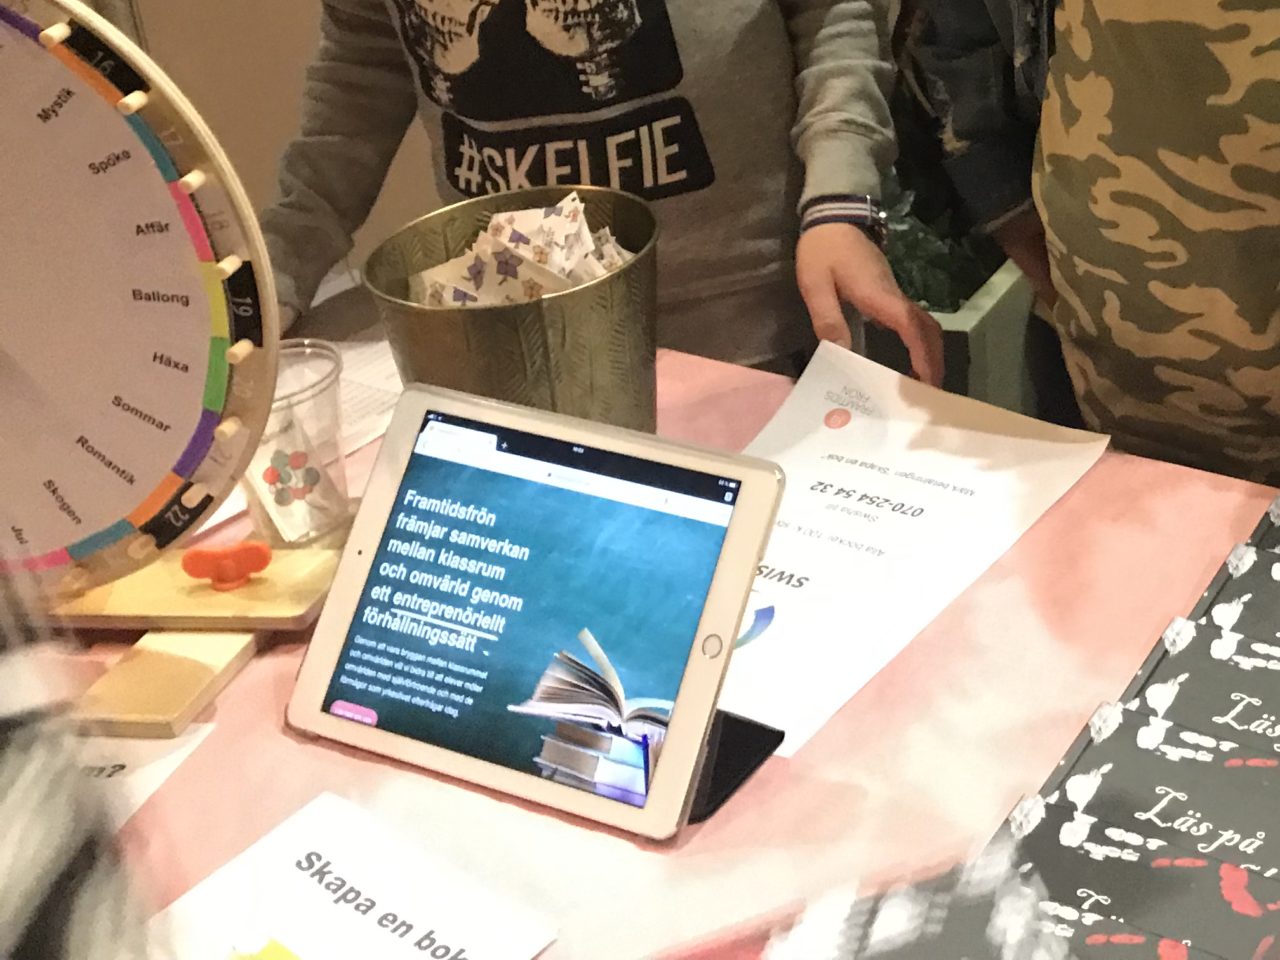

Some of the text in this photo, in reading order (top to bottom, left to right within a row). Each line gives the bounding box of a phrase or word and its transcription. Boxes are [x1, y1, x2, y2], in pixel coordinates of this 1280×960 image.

[91, 51, 115, 75] 16
[36, 87, 76, 124] Mystik
[88, 148, 131, 175] Spöke
[135, 221, 170, 237] Affär
[132, 289, 189, 308] Ballong
[232, 298, 253, 317] 19
[152, 351, 190, 373] Häxa
[111, 395, 172, 432] Sommar
[75, 435, 137, 486] Romantik
[43, 479, 82, 525] Skogen
[165, 505, 190, 528] 22
[403, 489, 497, 527] Framtidsfrön
[809, 480, 925, 518] 070-254 54 32
[395, 512, 530, 561] främjar samverkan
[387, 538, 506, 581] mellan klassrum
[379, 561, 524, 612] och omvärld genom
[371, 585, 506, 634] ett entreprenöriellt
[362, 606, 478, 653] förhållningssätt
[1134, 786, 1266, 854] Läs på
[295, 851, 377, 915] Skapa
[377, 912, 413, 938] en
